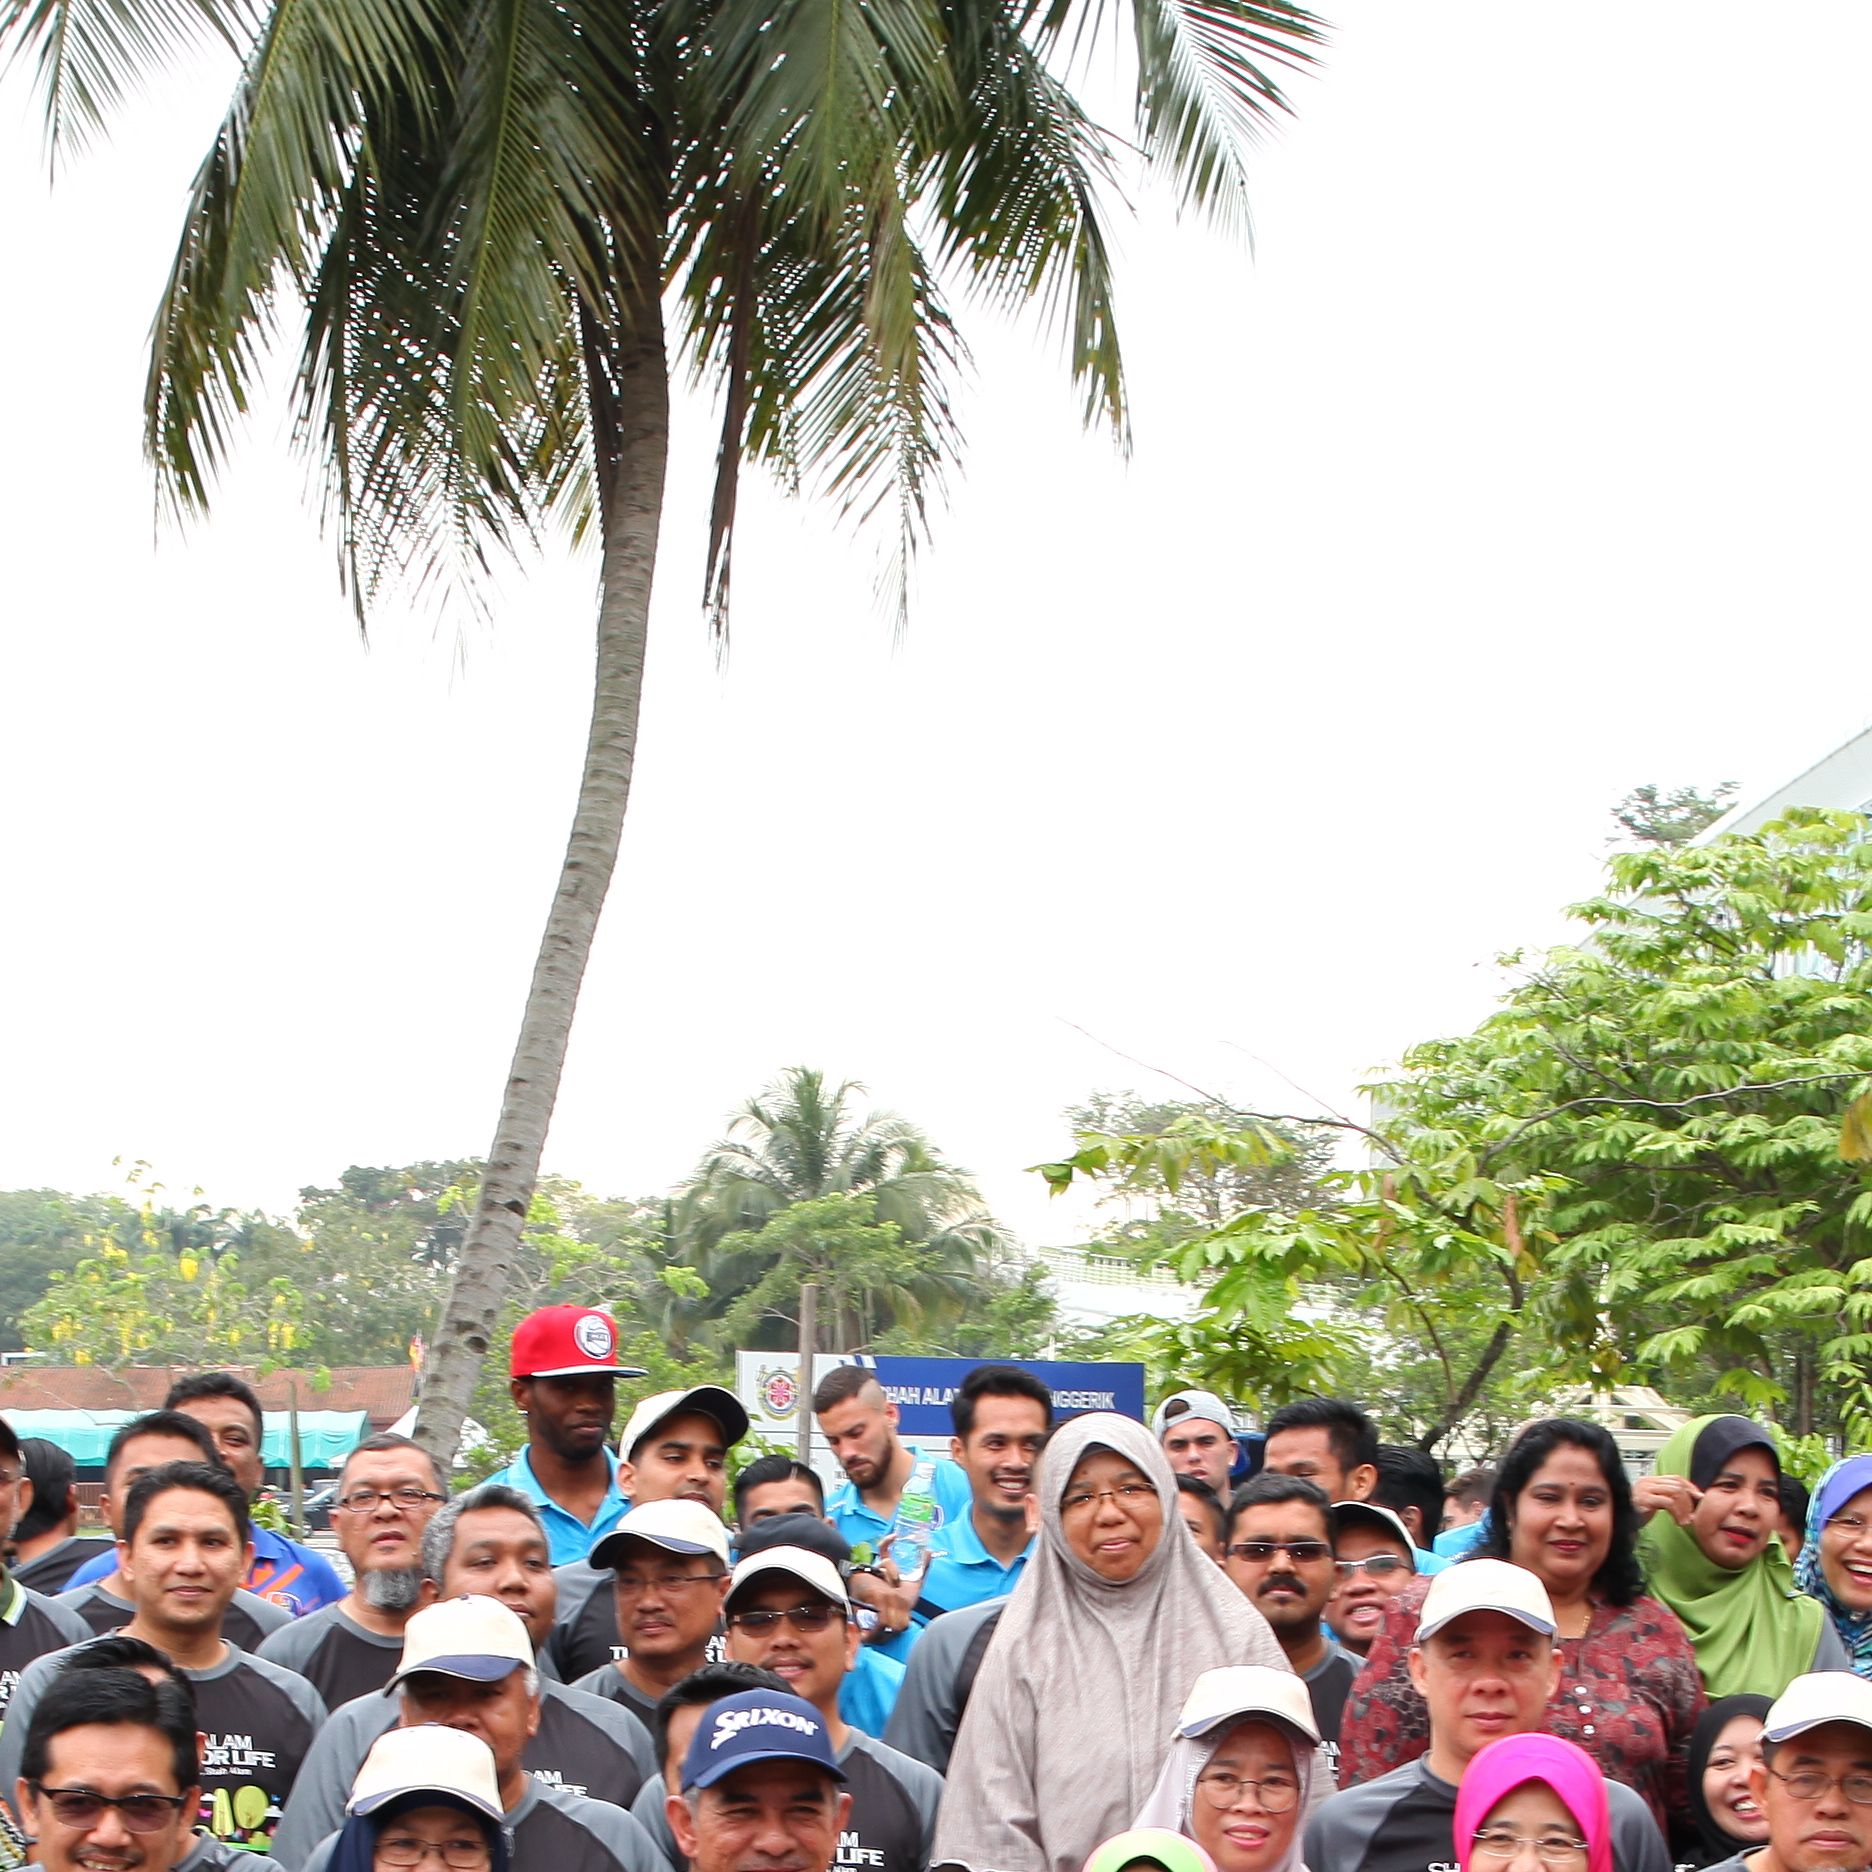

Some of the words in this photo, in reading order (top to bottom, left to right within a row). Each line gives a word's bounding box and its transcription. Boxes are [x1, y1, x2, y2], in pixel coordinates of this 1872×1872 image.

[710, 1707, 820, 1751] SRIXON
[204, 1732, 254, 1751] LAM
[231, 1749, 277, 1769] LIFE
[835, 1847, 885, 1867] LIFE
